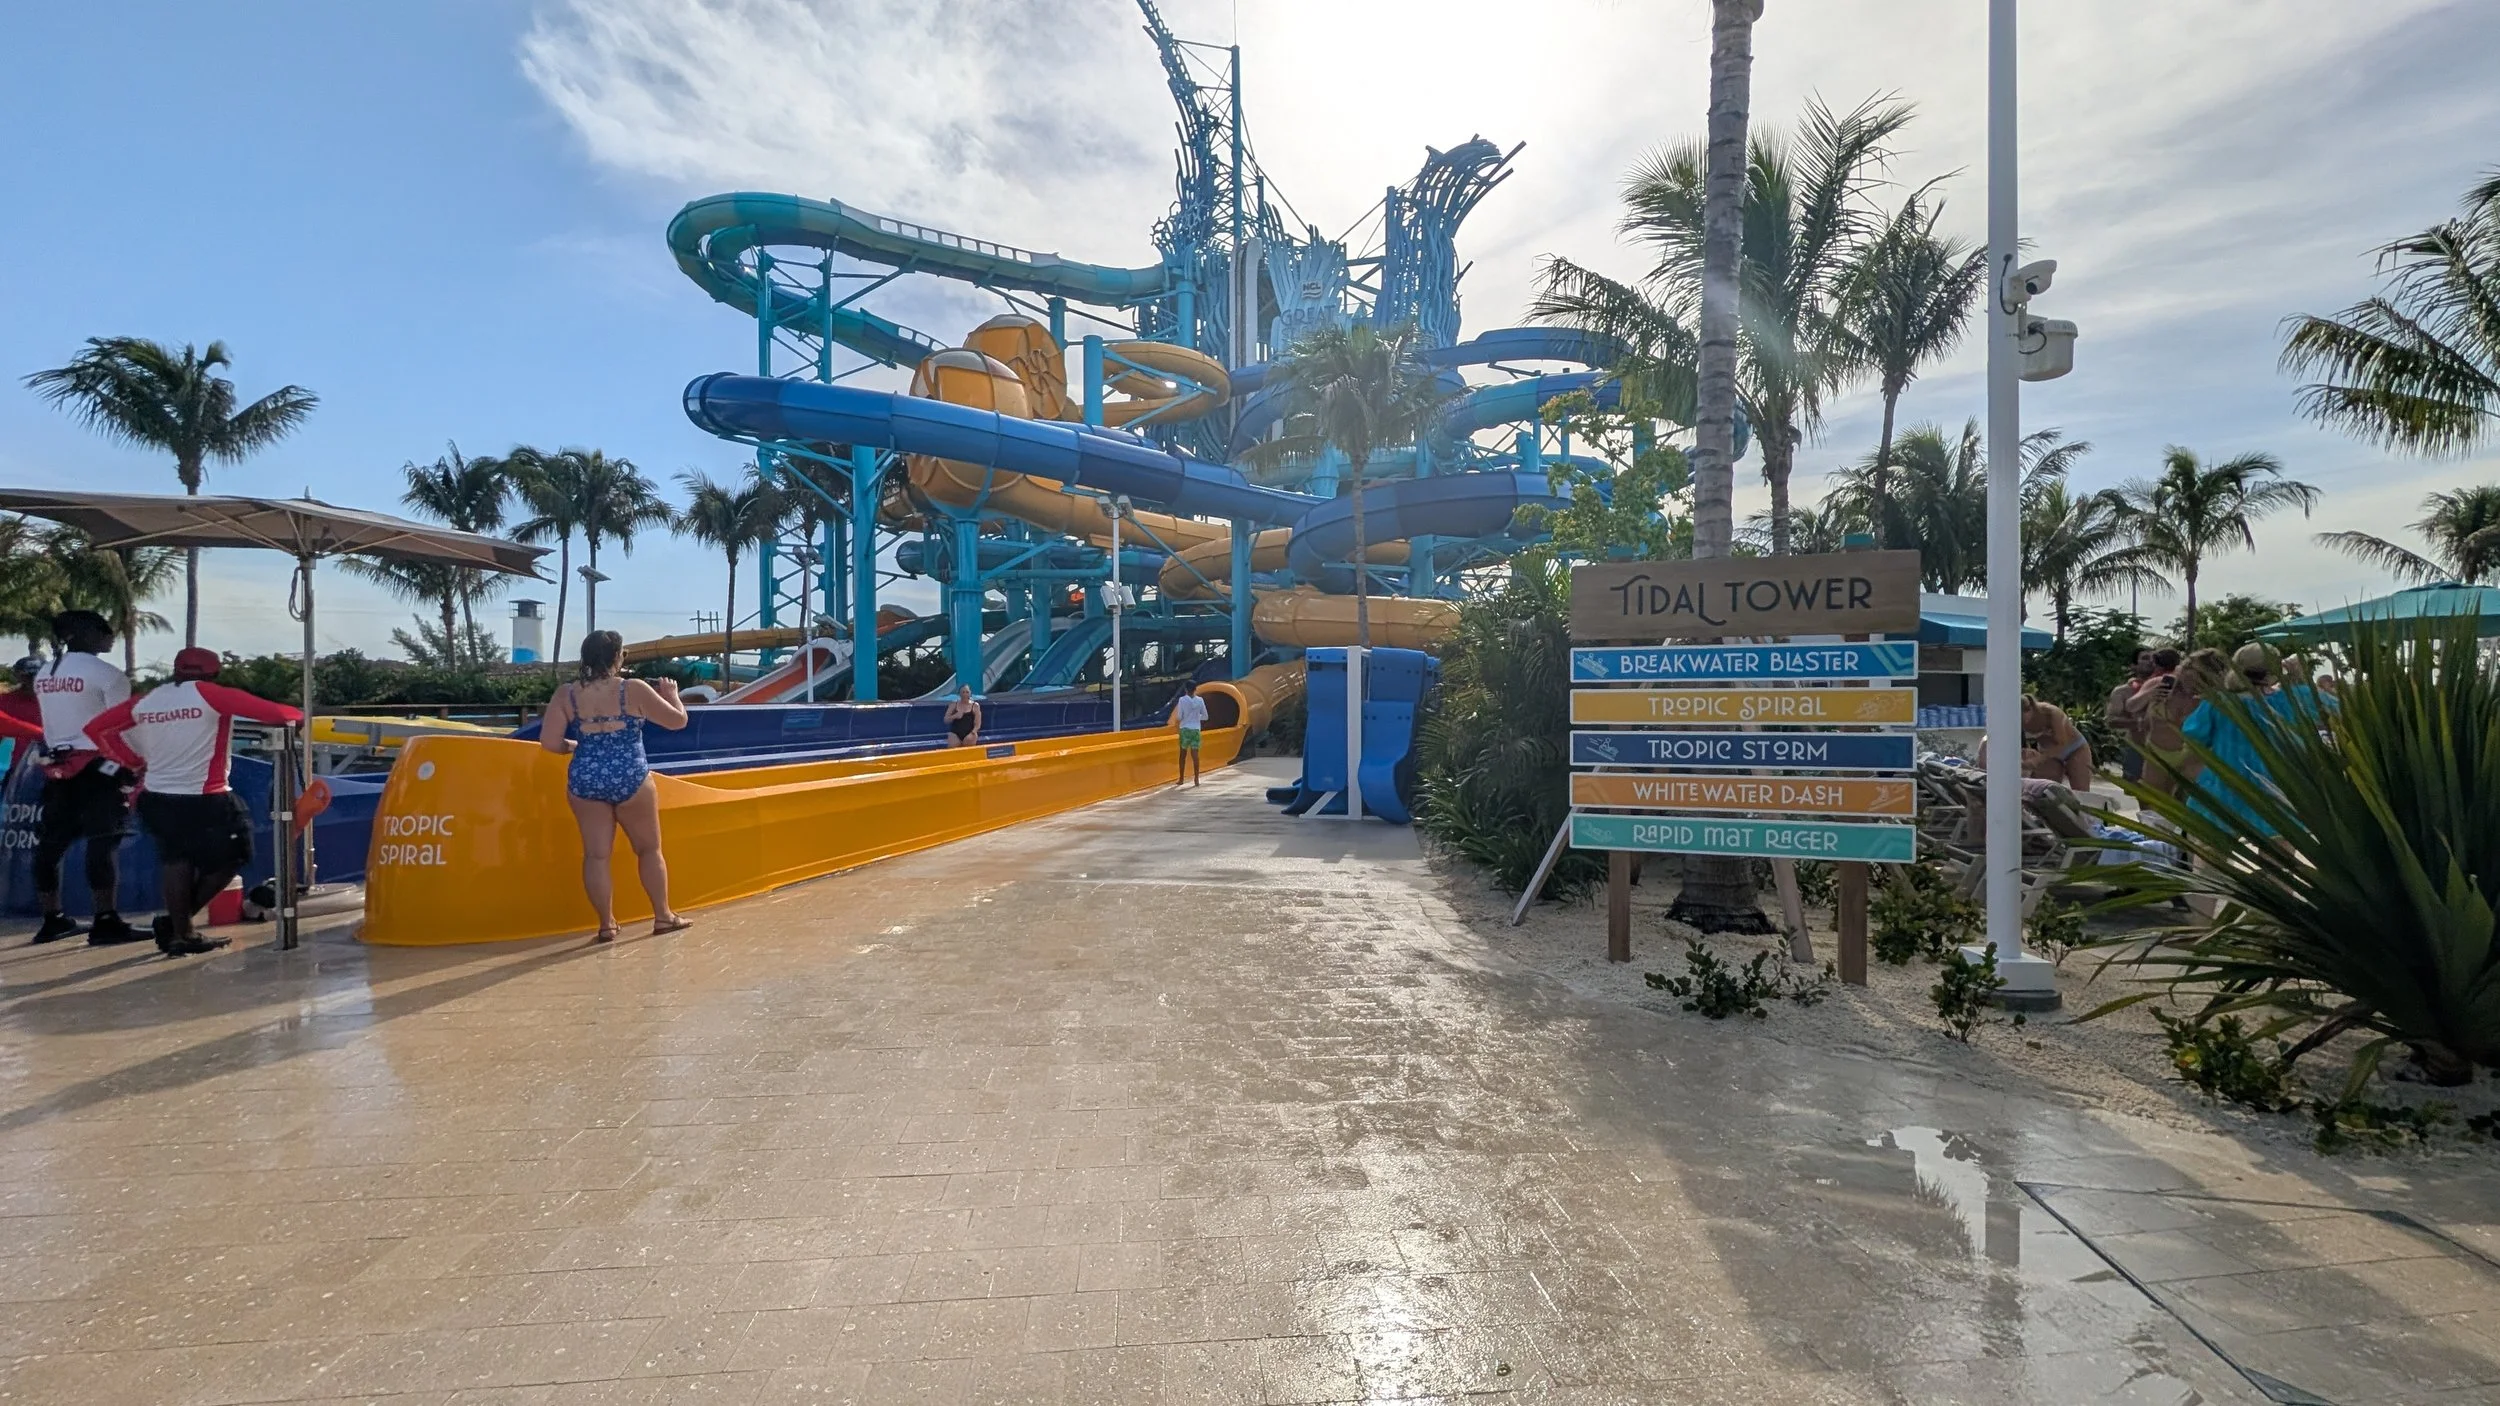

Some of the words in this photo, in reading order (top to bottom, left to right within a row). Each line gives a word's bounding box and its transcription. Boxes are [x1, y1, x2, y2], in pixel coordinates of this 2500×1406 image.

[1302, 282, 1321, 291] NCL
[1280, 304, 1336, 327] GREAT
[1610, 574, 1727, 626] TIDAL
[1724, 576, 1873, 613] TOWER
[1620, 650, 1760, 674] BREAKWATER
[1770, 650, 1860, 673] BLASTER
[1648, 695, 1729, 717] TROPIC
[1738, 696, 1828, 721] SPIRAL
[1647, 739, 1732, 761] TROPIC
[1742, 740, 1828, 762] STORM
[1632, 781, 1774, 804] WHITEWATER
[1780, 784, 1844, 806] DASH
[383, 815, 455, 836] TROPIC
[1632, 823, 1695, 846] RAPID
[1764, 829, 1839, 852] RACER
